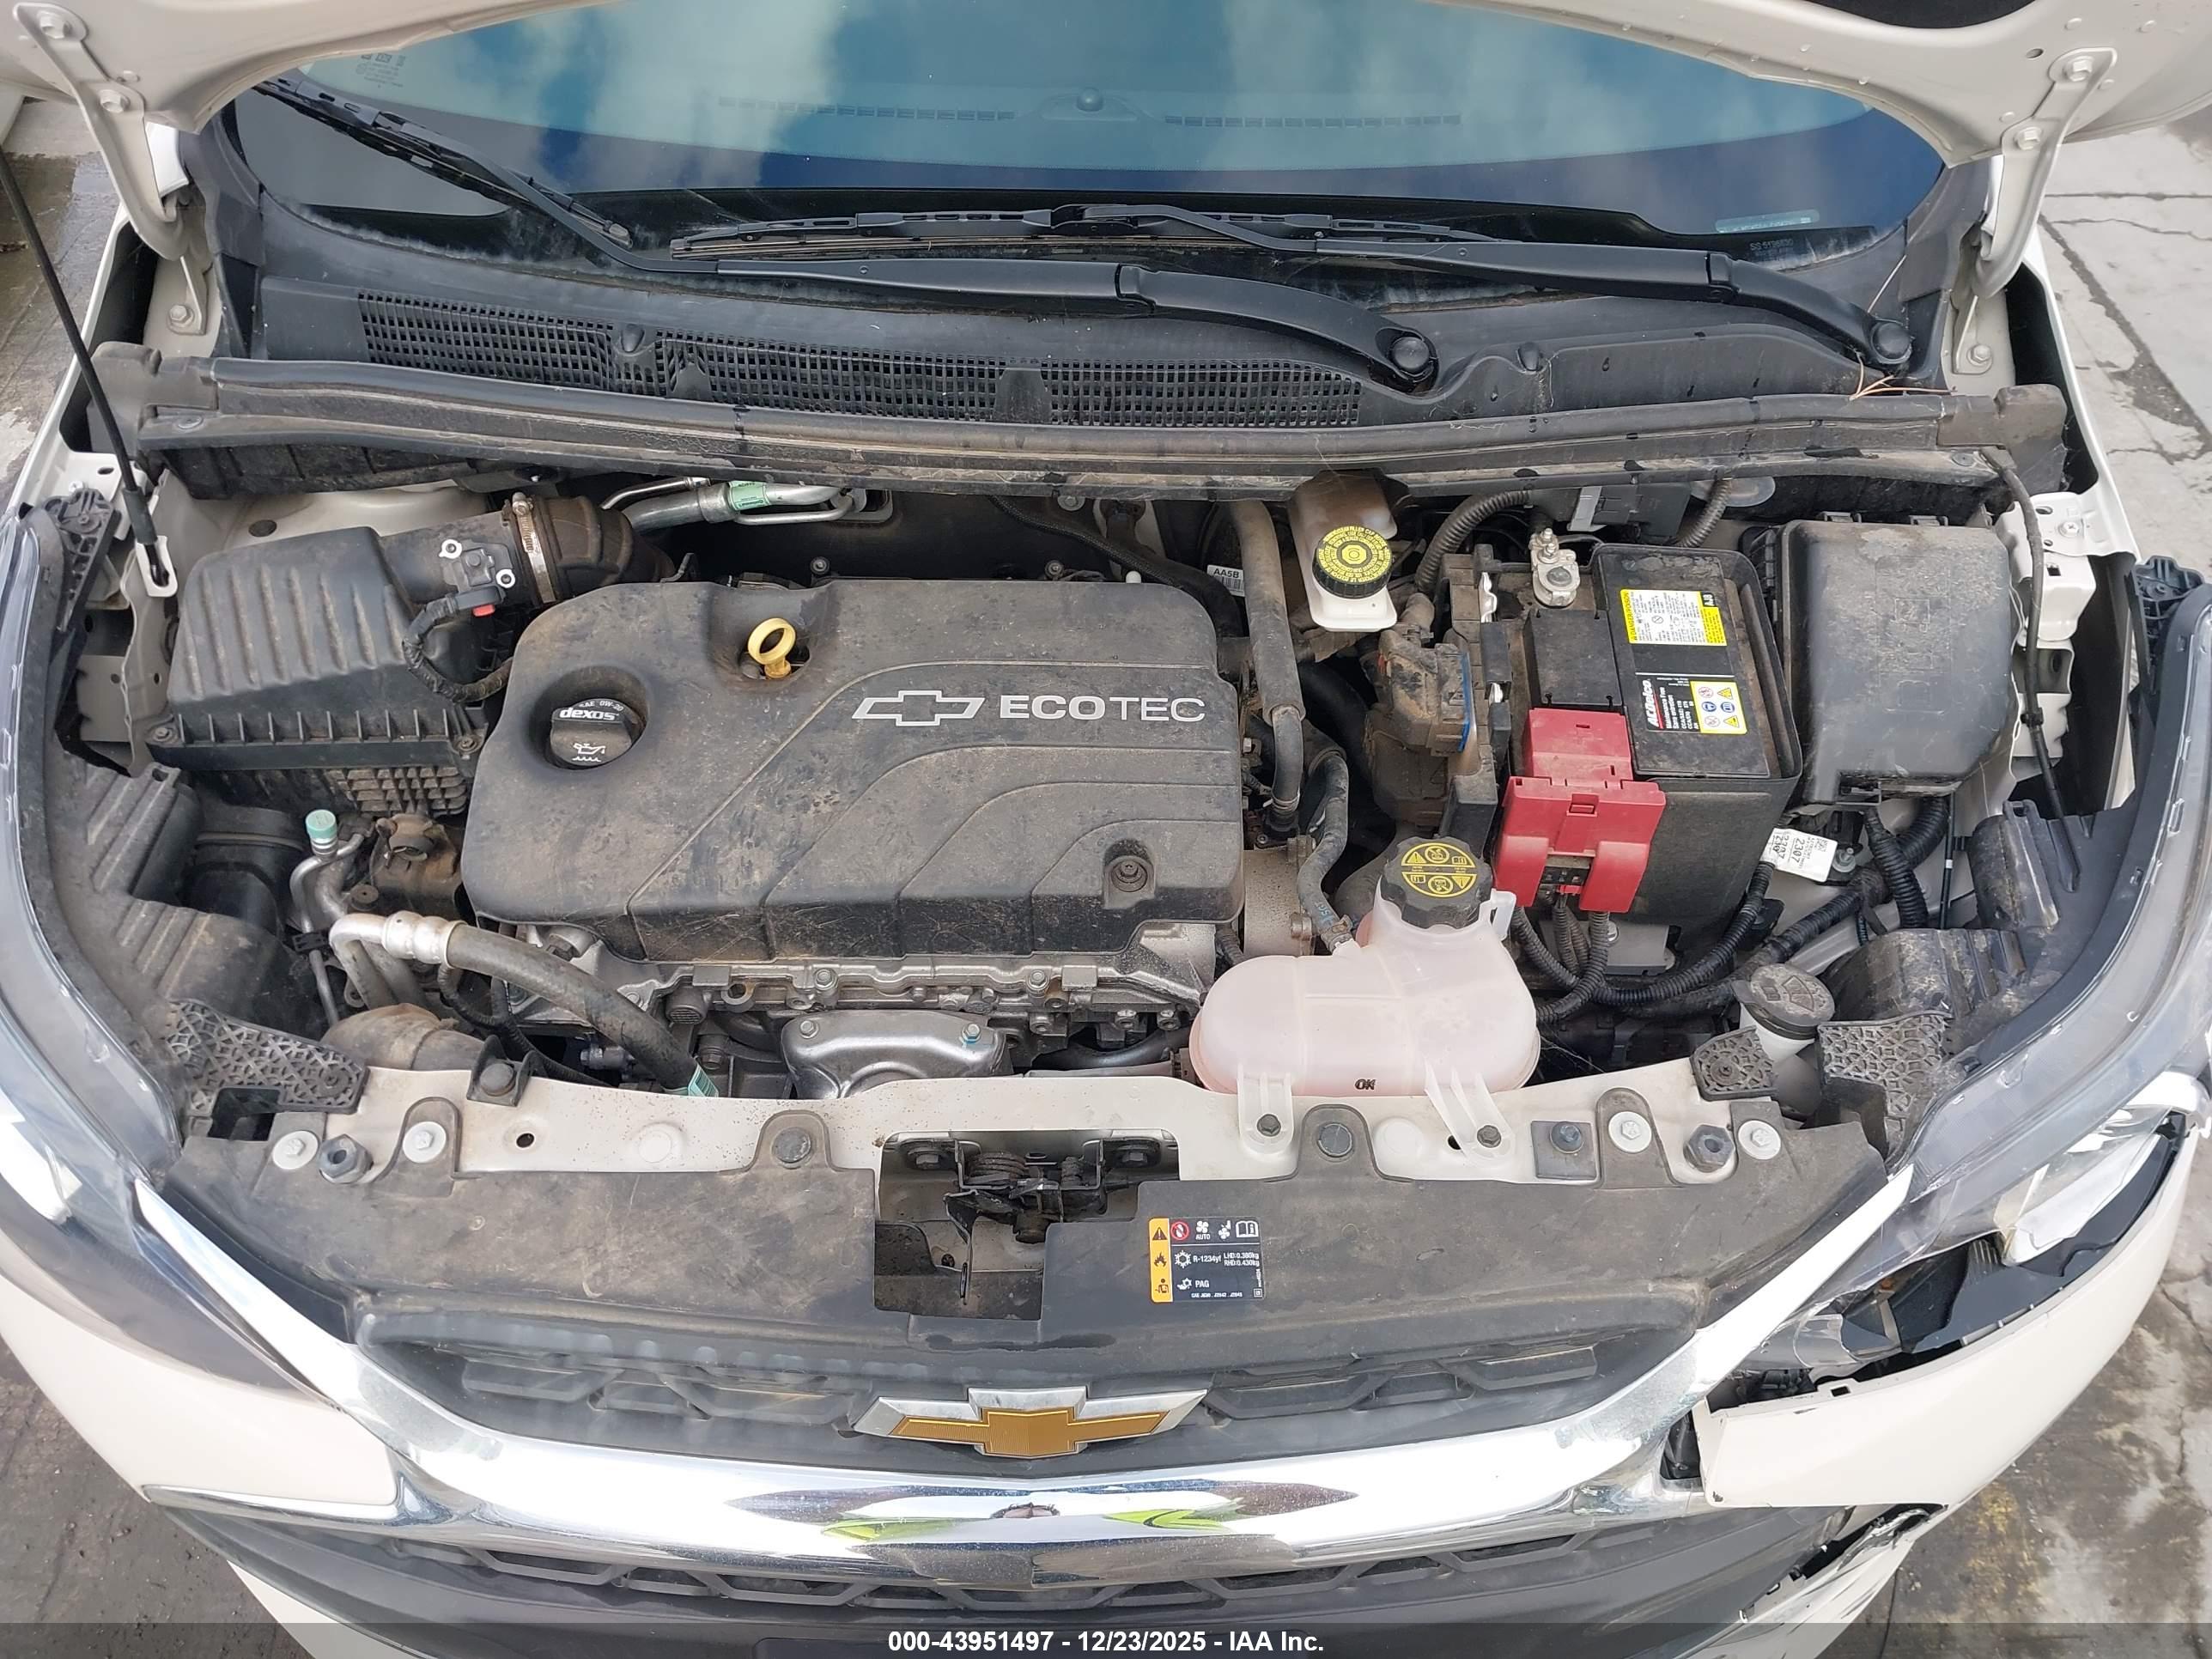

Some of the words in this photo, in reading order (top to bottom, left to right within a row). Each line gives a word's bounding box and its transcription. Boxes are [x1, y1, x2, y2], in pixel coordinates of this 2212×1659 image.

[1213, 568, 1239, 579] AA5B
[599, 700, 624, 712] 0W-20
[1000, 694, 1206, 723] ECOTEC
[1642, 679, 1660, 727] ACDelco
[559, 707, 617, 721] dexos
[1662, 698, 1673, 729] Maintenance
[1790, 837, 1806, 863] 2307
[1354, 1079, 1376, 1091] OK
[1193, 1254, 1222, 1263] R-1234yf
[1194, 1279, 1210, 1288] PAG
